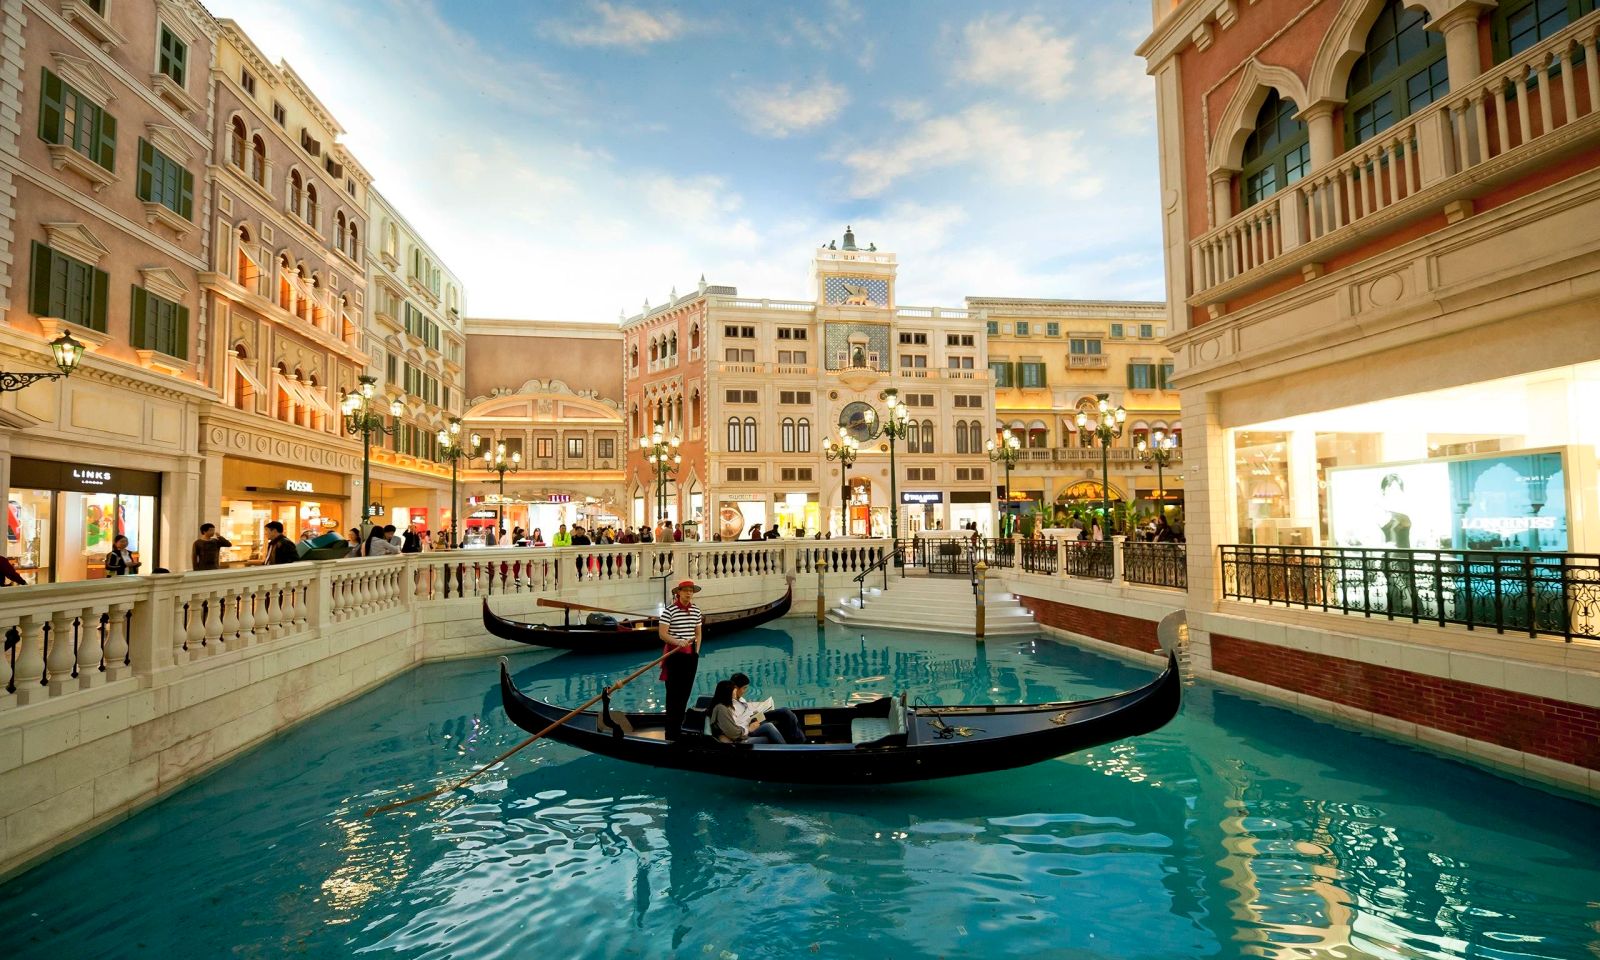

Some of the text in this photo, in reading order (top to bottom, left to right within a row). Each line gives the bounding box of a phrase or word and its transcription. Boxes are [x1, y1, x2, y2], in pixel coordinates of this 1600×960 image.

[73, 469, 111, 480] LINKS
[286, 480, 314, 492] FOSSIL
[1461, 517, 1556, 529] LONGINES
